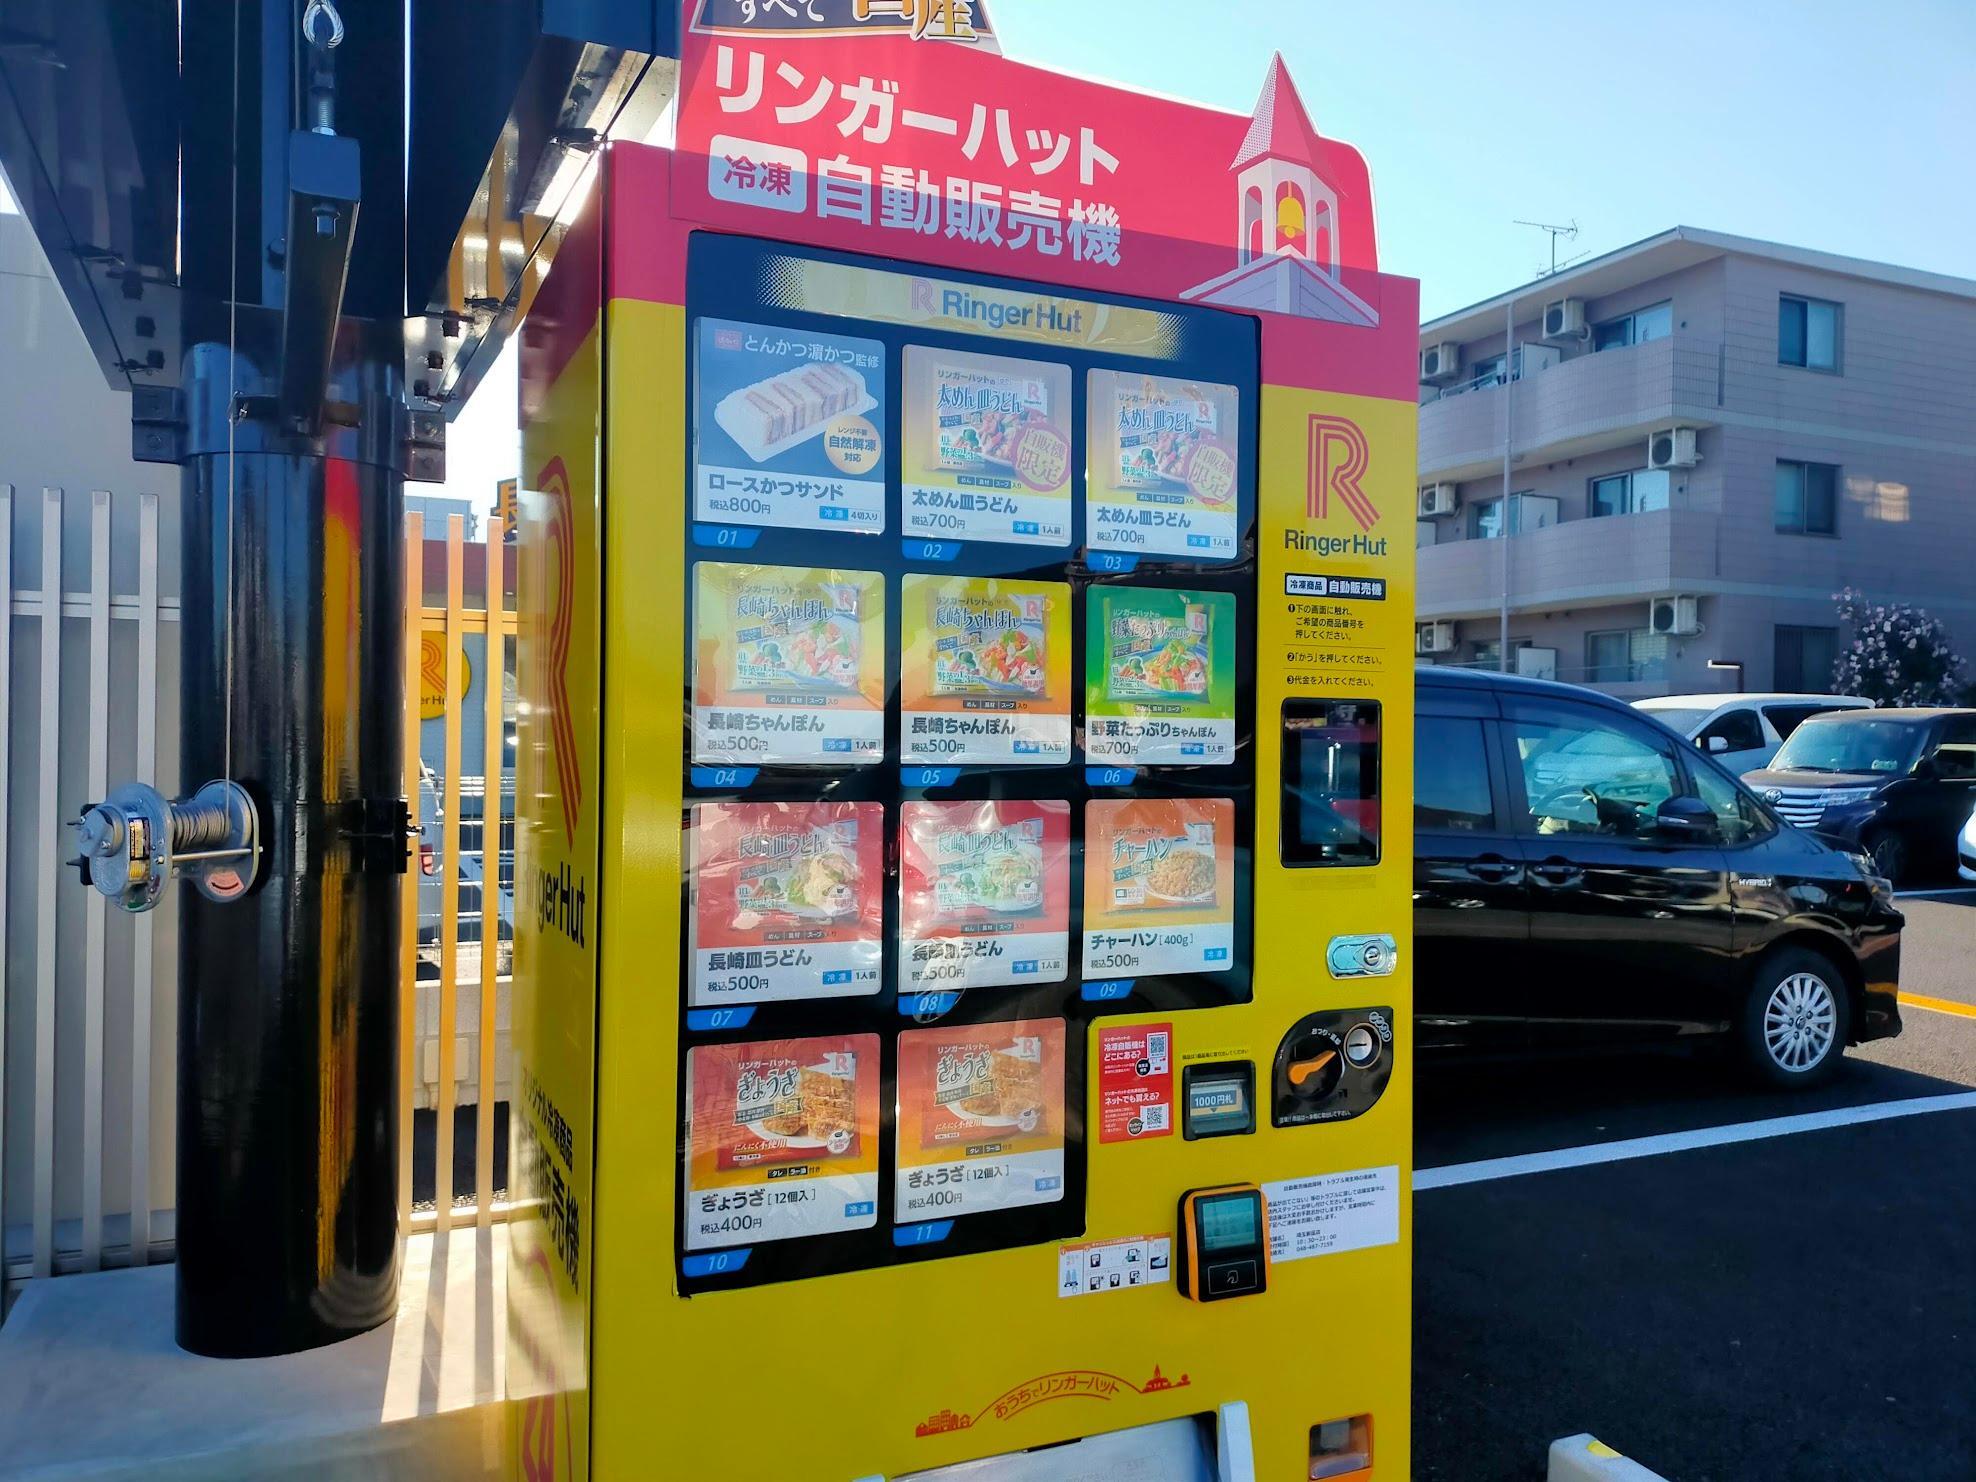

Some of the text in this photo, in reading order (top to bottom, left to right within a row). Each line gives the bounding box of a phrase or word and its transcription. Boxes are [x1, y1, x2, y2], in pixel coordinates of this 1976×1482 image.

[715, 45, 1120, 185] リンガーハット
[722, 153, 1122, 267] 冷凍 自動販売機
[937, 369, 996, 385] リンガーハットの
[937, 383, 1023, 414] 太めん皿うどん
[1118, 405, 1196, 433] 太めん皿うどん
[829, 435, 877, 452] 自然解凍
[844, 452, 862, 462] 対応
[1306, 413, 1381, 532] R
[708, 473, 845, 501] ロースかつサンド
[709, 497, 771, 514] 税込800円
[912, 489, 1018, 515] 太めん皿うどん
[851, 511, 878, 521] 4切入り
[911, 513, 965, 529] 税込700円
[1097, 507, 1191, 528] 太めん皿うどん
[717, 529, 738, 545] 01
[1042, 525, 1061, 535] 1人前
[1097, 529, 1145, 544] 税込700円
[1213, 538, 1230, 547] 1人前
[923, 544, 942, 559] 02
[1105, 555, 1121, 569] 03
[1290, 579, 1383, 597] 冷凍商品 自動販売機
[736, 596, 831, 621] 長崎ちゃんぽん
[935, 607, 1020, 630] 長崎ちゃんぽん
[1296, 617, 1364, 629] ご希望の商品番号を
[1295, 629, 1352, 641] 押してください。
[1295, 675, 1374, 687] 代金を入れてください。
[707, 712, 825, 733] 長崎ちゃんぽん
[911, 718, 1015, 735] 長崎ちゃんぽん
[1091, 721, 1216, 738] 野菜たっぷりちゃんぽん
[911, 738, 965, 753] 税込500円
[1091, 741, 1138, 755] 税込700円
[715, 770, 736, 785] 04
[921, 769, 940, 784] 05
[1104, 769, 1120, 784] 06
[740, 832, 827, 858] 長崎皿うどん
[1113, 837, 1172, 864] チャーハン
[559, 861, 586, 949] Hut
[1090, 933, 1158, 950] チャーハン
[708, 949, 811, 971] 長崎皿うどん
[1090, 953, 1139, 969] 税込500円
[707, 975, 769, 992] 税込500円
[855, 970, 877, 981] 1人前
[1100, 983, 1117, 997] 09
[919, 996, 937, 1011] 08
[711, 1011, 733, 1027] 07
[738, 1059, 797, 1071] リンガーハットの
[936, 1050, 991, 1084] ぎょうざ
[738, 1067, 799, 1101] ぎょうざ
[1194, 1093, 1233, 1107] 1000円札
[908, 1165, 965, 1189] ぎょうざ
[701, 1189, 765, 1213] ぎょうざ
[908, 1190, 962, 1209] 税込400円
[701, 1215, 762, 1235] 税込400円
[916, 1225, 933, 1241] 11
[707, 1254, 728, 1271] 10
